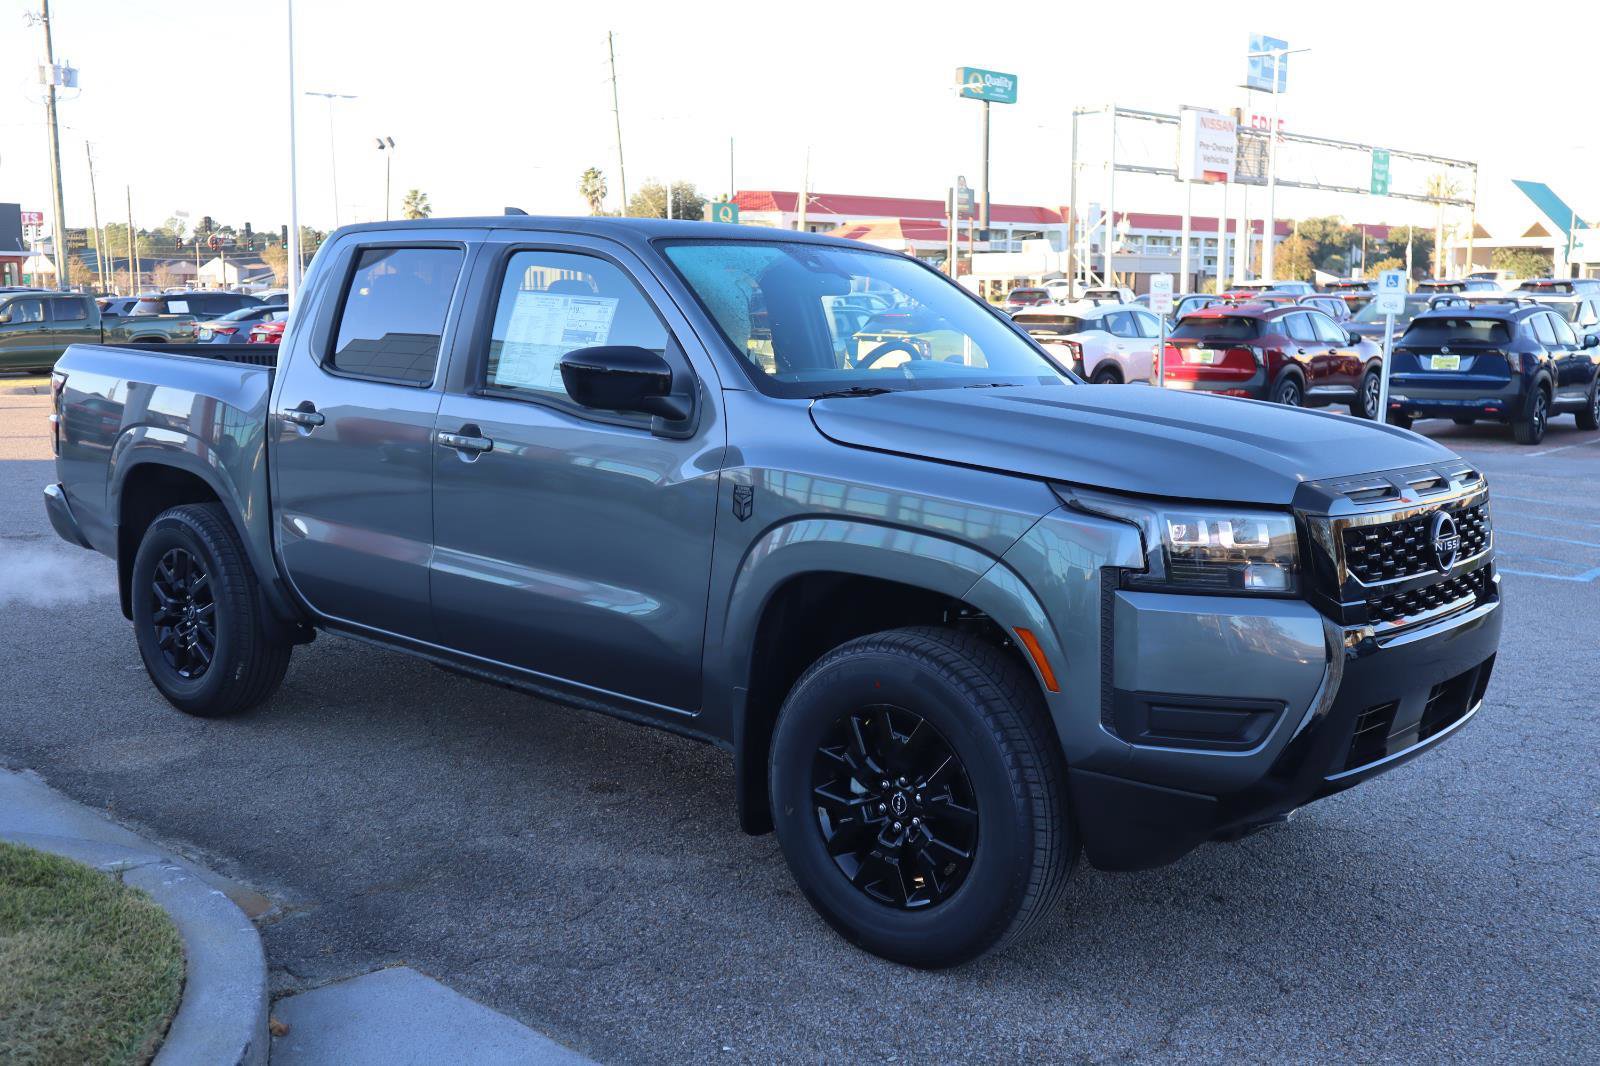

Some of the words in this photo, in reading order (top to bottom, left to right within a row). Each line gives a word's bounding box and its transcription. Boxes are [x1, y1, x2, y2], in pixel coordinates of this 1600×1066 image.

[985, 74, 1013, 91] Quality
[1200, 117, 1235, 132] NISSAN
[1200, 141, 1234, 153] Pre-Owned
[1203, 154, 1230, 165] Vehicles
[719, 206, 733, 222] Q
